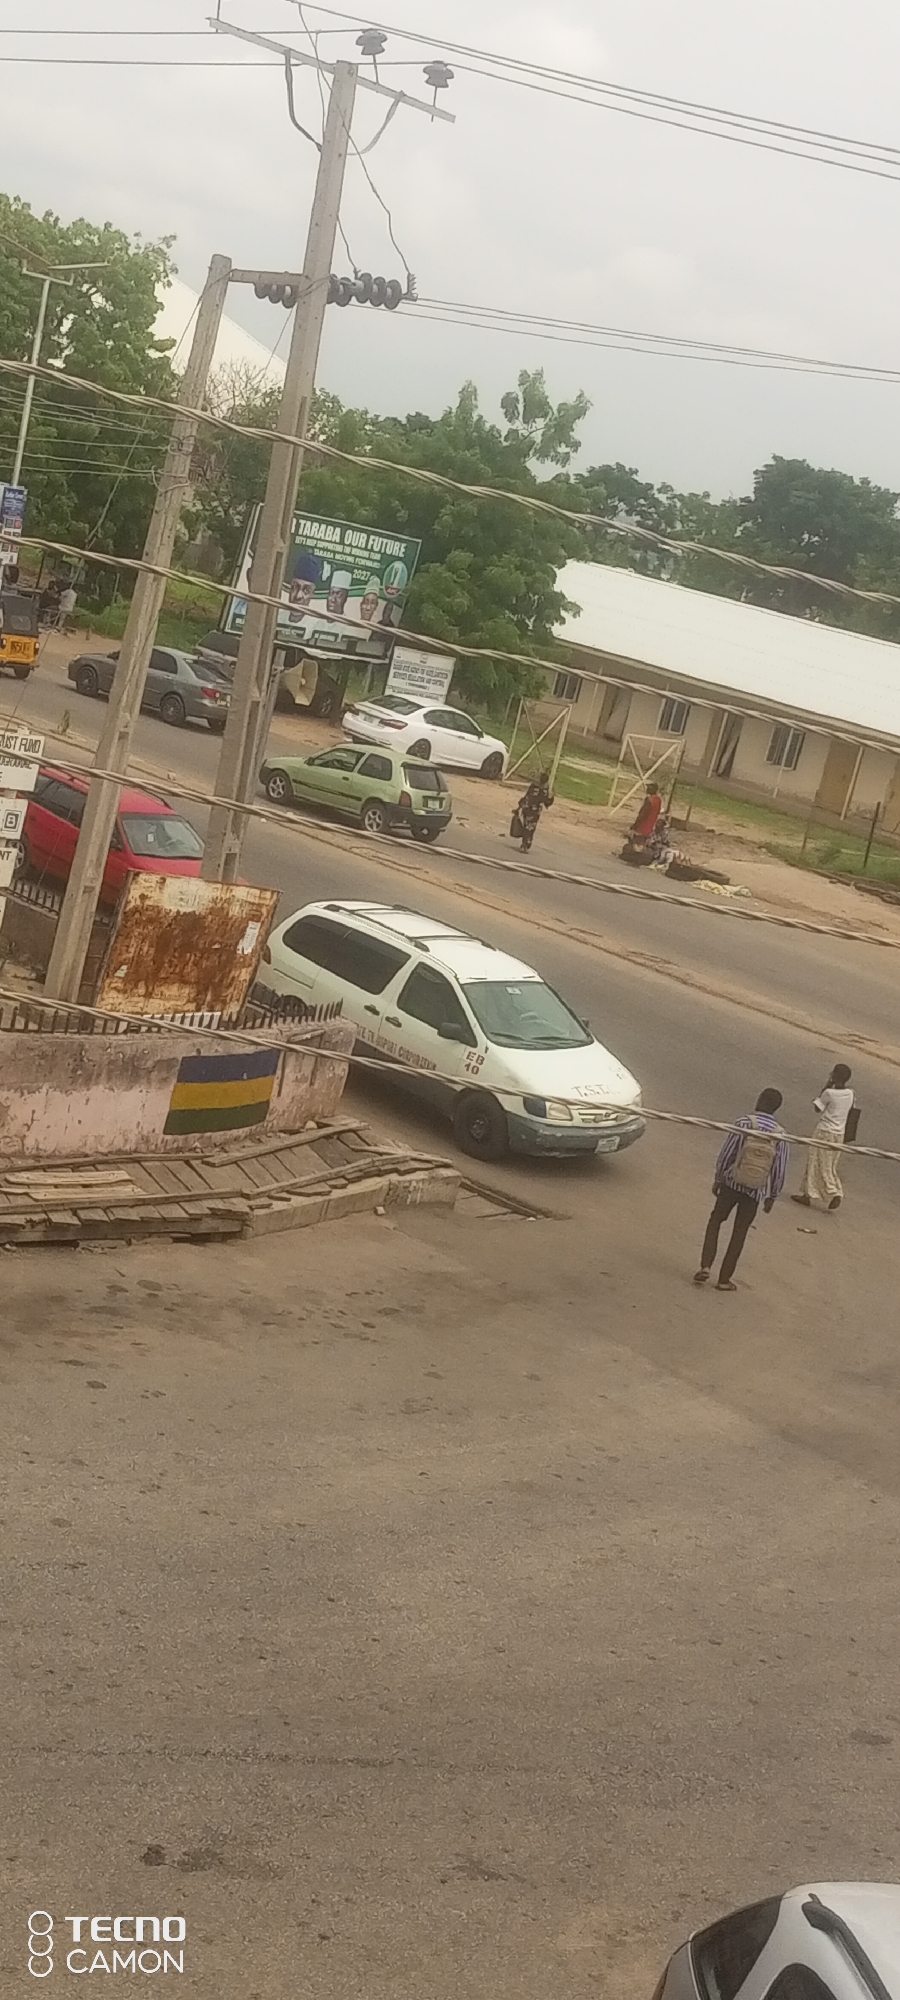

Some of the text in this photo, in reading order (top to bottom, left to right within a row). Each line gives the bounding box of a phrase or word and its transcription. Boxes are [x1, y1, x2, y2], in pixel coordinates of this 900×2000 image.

[298, 519, 341, 543] TARABA
[344, 529, 367, 548] OUR
[367, 535, 407, 557] FUTURE
[353, 569, 371, 581] 2027
[19, 737, 42, 754] FUND
[465, 1050, 486, 1066] EB
[464, 1062, 480, 1076] 10
